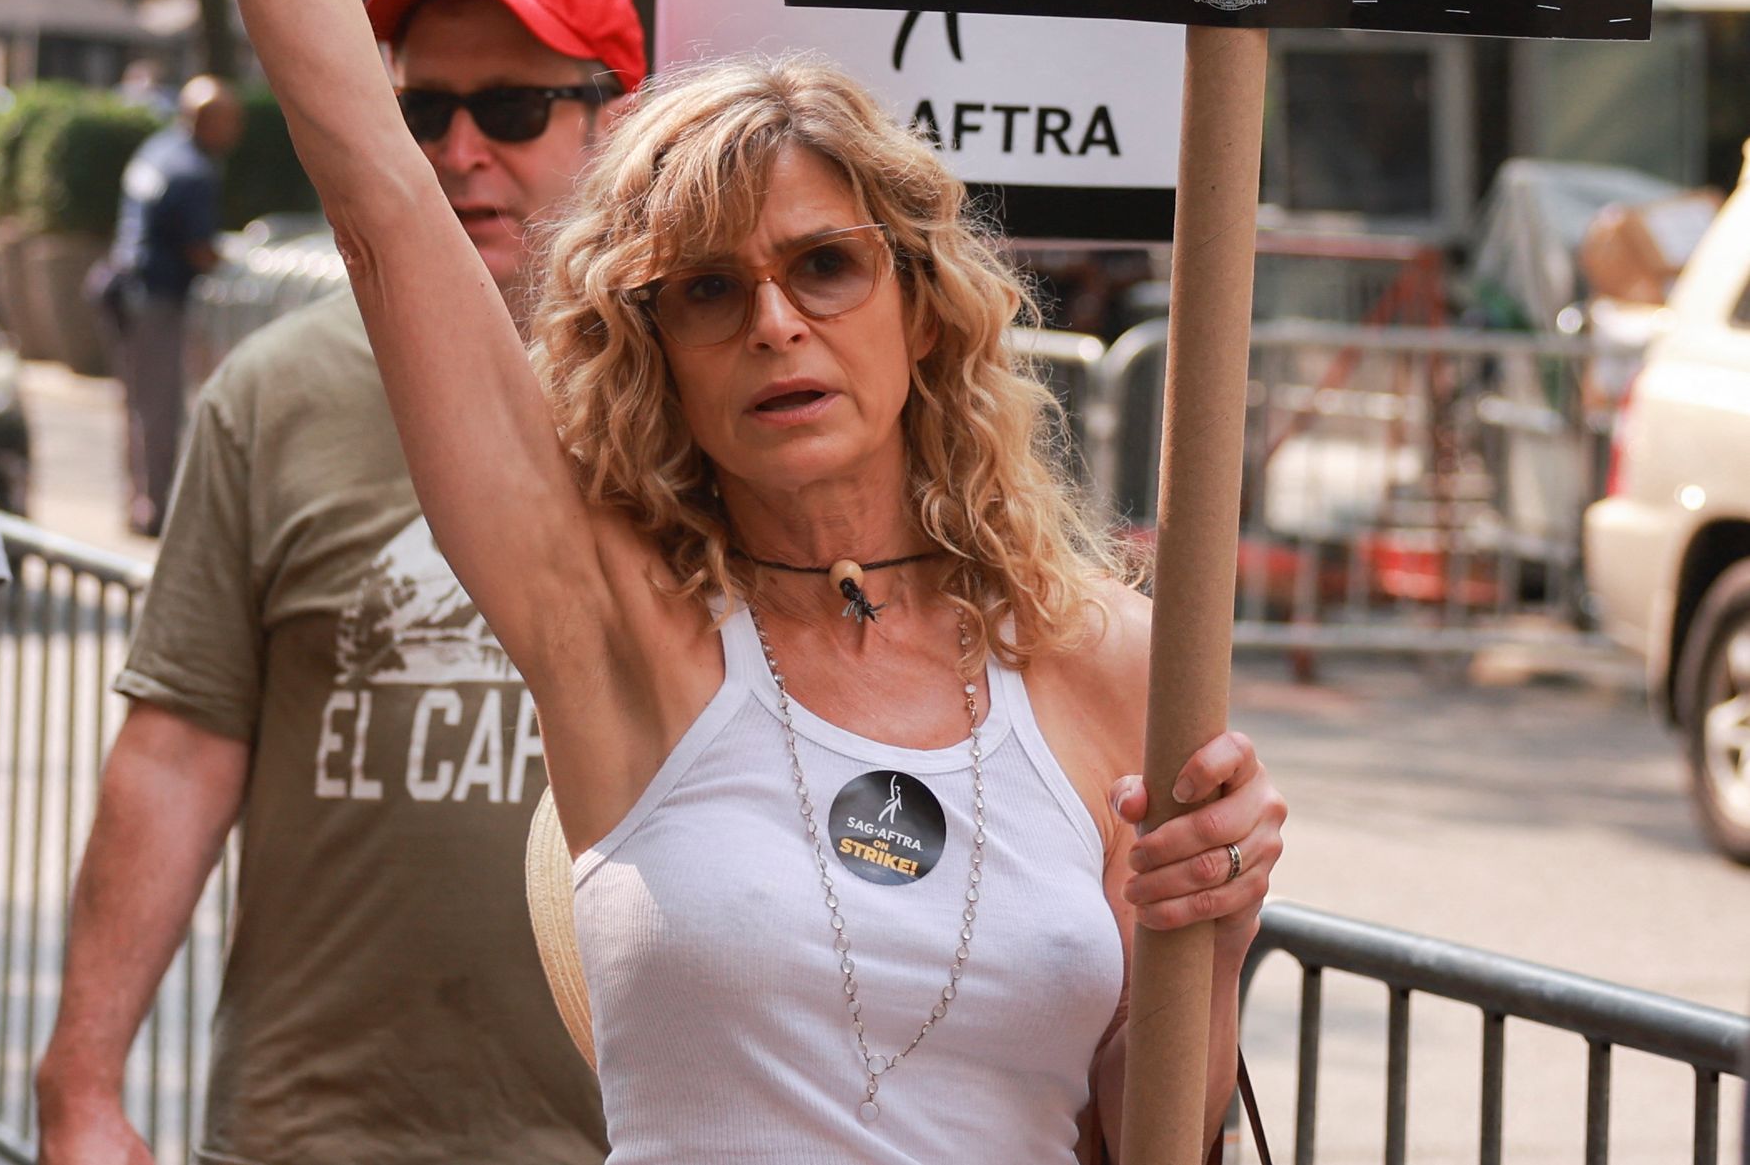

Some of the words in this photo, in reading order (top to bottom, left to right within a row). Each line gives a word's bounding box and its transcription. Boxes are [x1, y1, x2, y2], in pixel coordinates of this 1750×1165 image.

[910, 99, 1121, 157] AFTRA
[315, 690, 383, 801] EL
[838, 837, 919, 877] STRIKE!
[873, 839, 890, 851] ON
